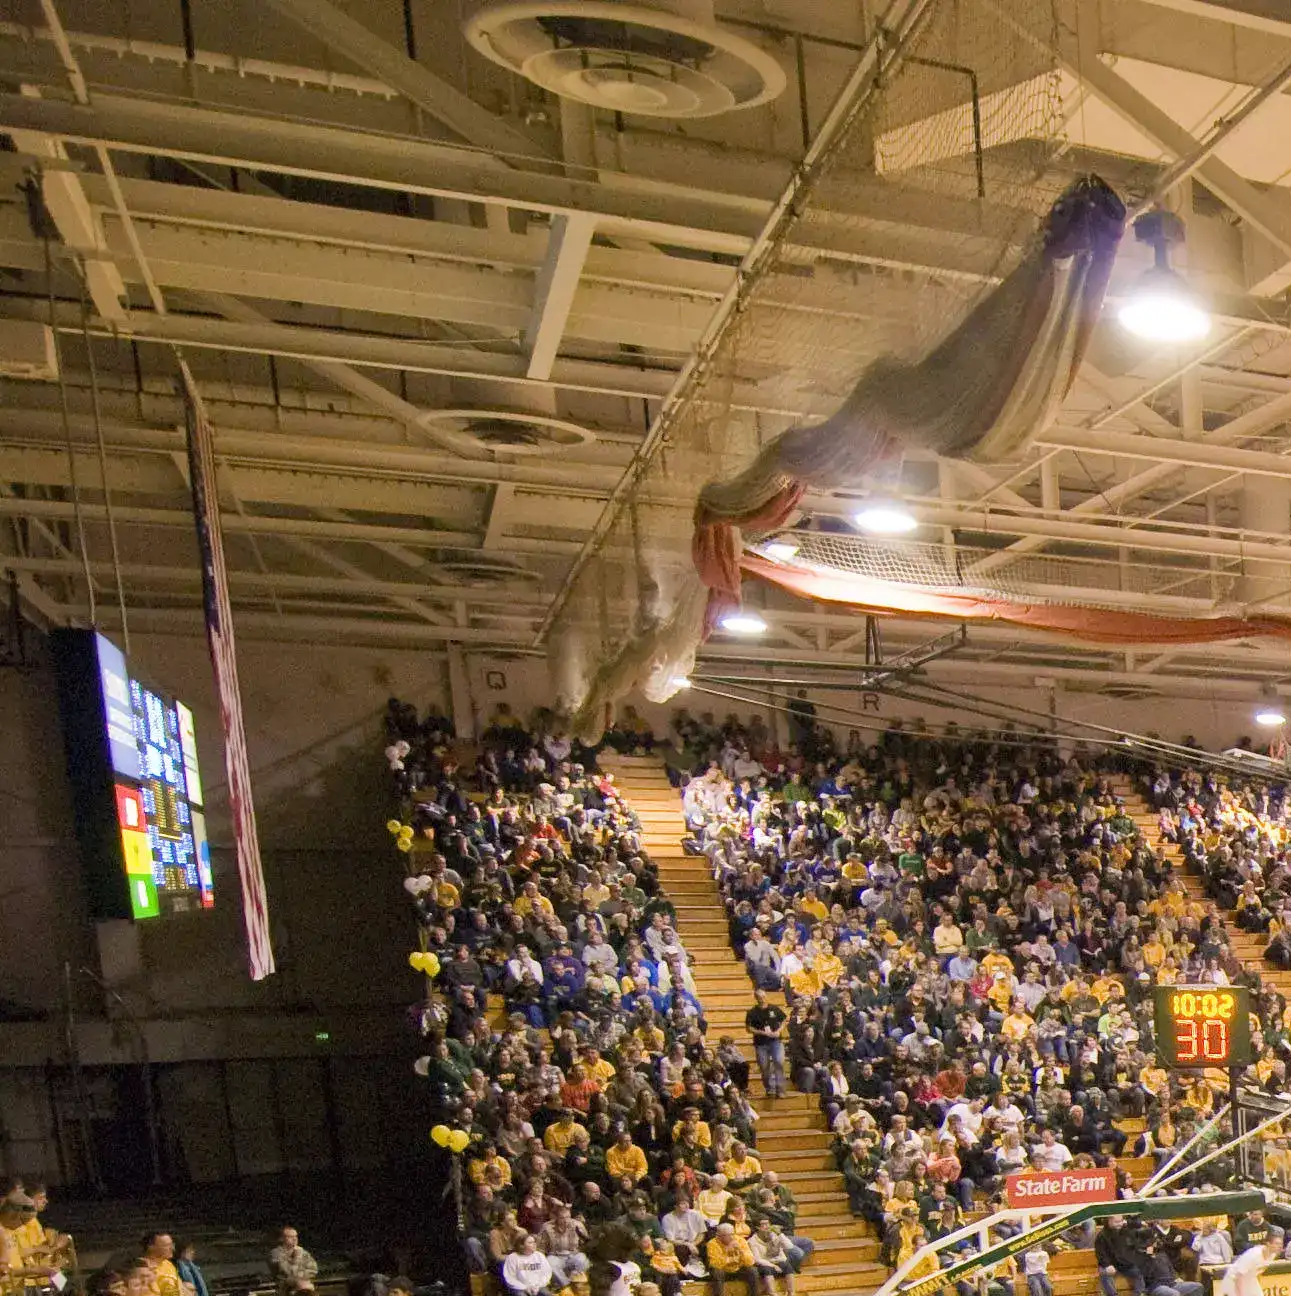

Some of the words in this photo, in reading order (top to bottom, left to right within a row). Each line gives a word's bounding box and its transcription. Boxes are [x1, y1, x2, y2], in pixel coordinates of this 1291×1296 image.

[863, 693, 880, 711] R
[1173, 993, 1234, 1018] 10:02
[1175, 1019, 1227, 1059] 30
[1015, 1178, 1061, 1197] State
[1061, 1175, 1108, 1193] Farm
